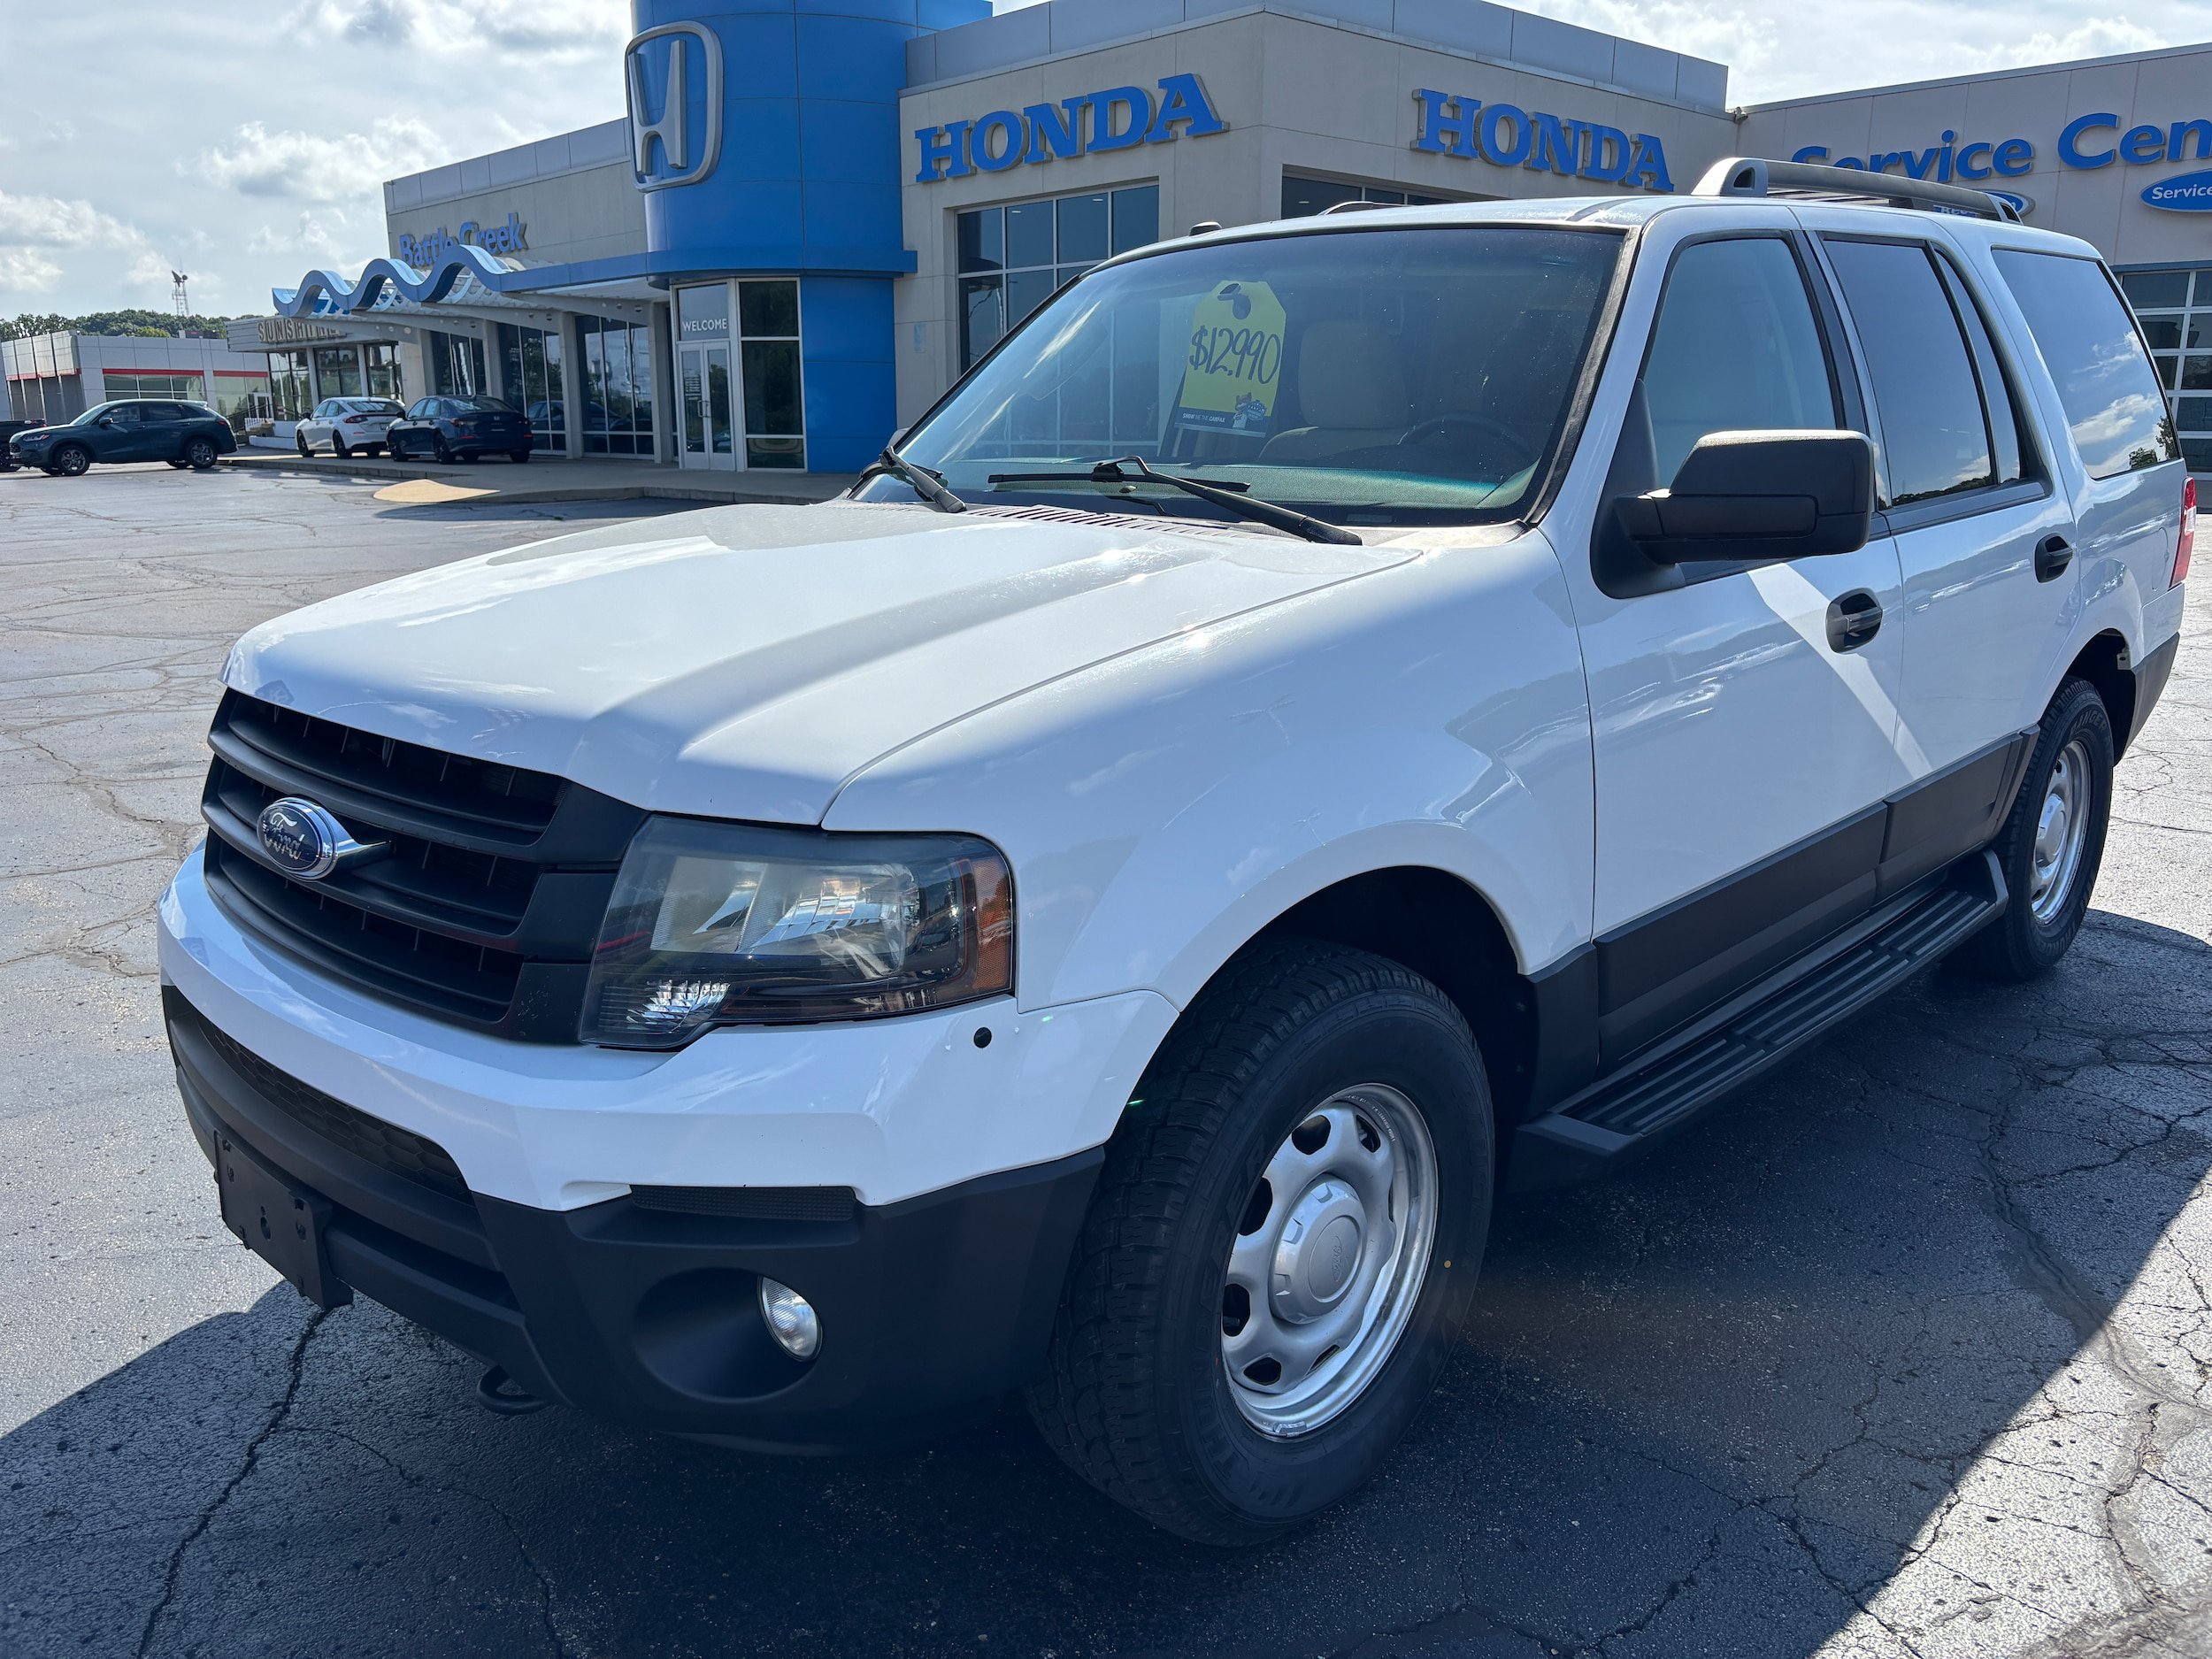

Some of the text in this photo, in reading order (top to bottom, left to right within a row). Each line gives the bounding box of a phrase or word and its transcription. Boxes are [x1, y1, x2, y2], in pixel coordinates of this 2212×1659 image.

[915, 73, 1228, 183] HONDA
[1410, 88, 1675, 193] HONDA
[1791, 112, 2212, 183] rvice Cen
[459, 212, 526, 255] Creek
[682, 318, 727, 332] WELCOME
